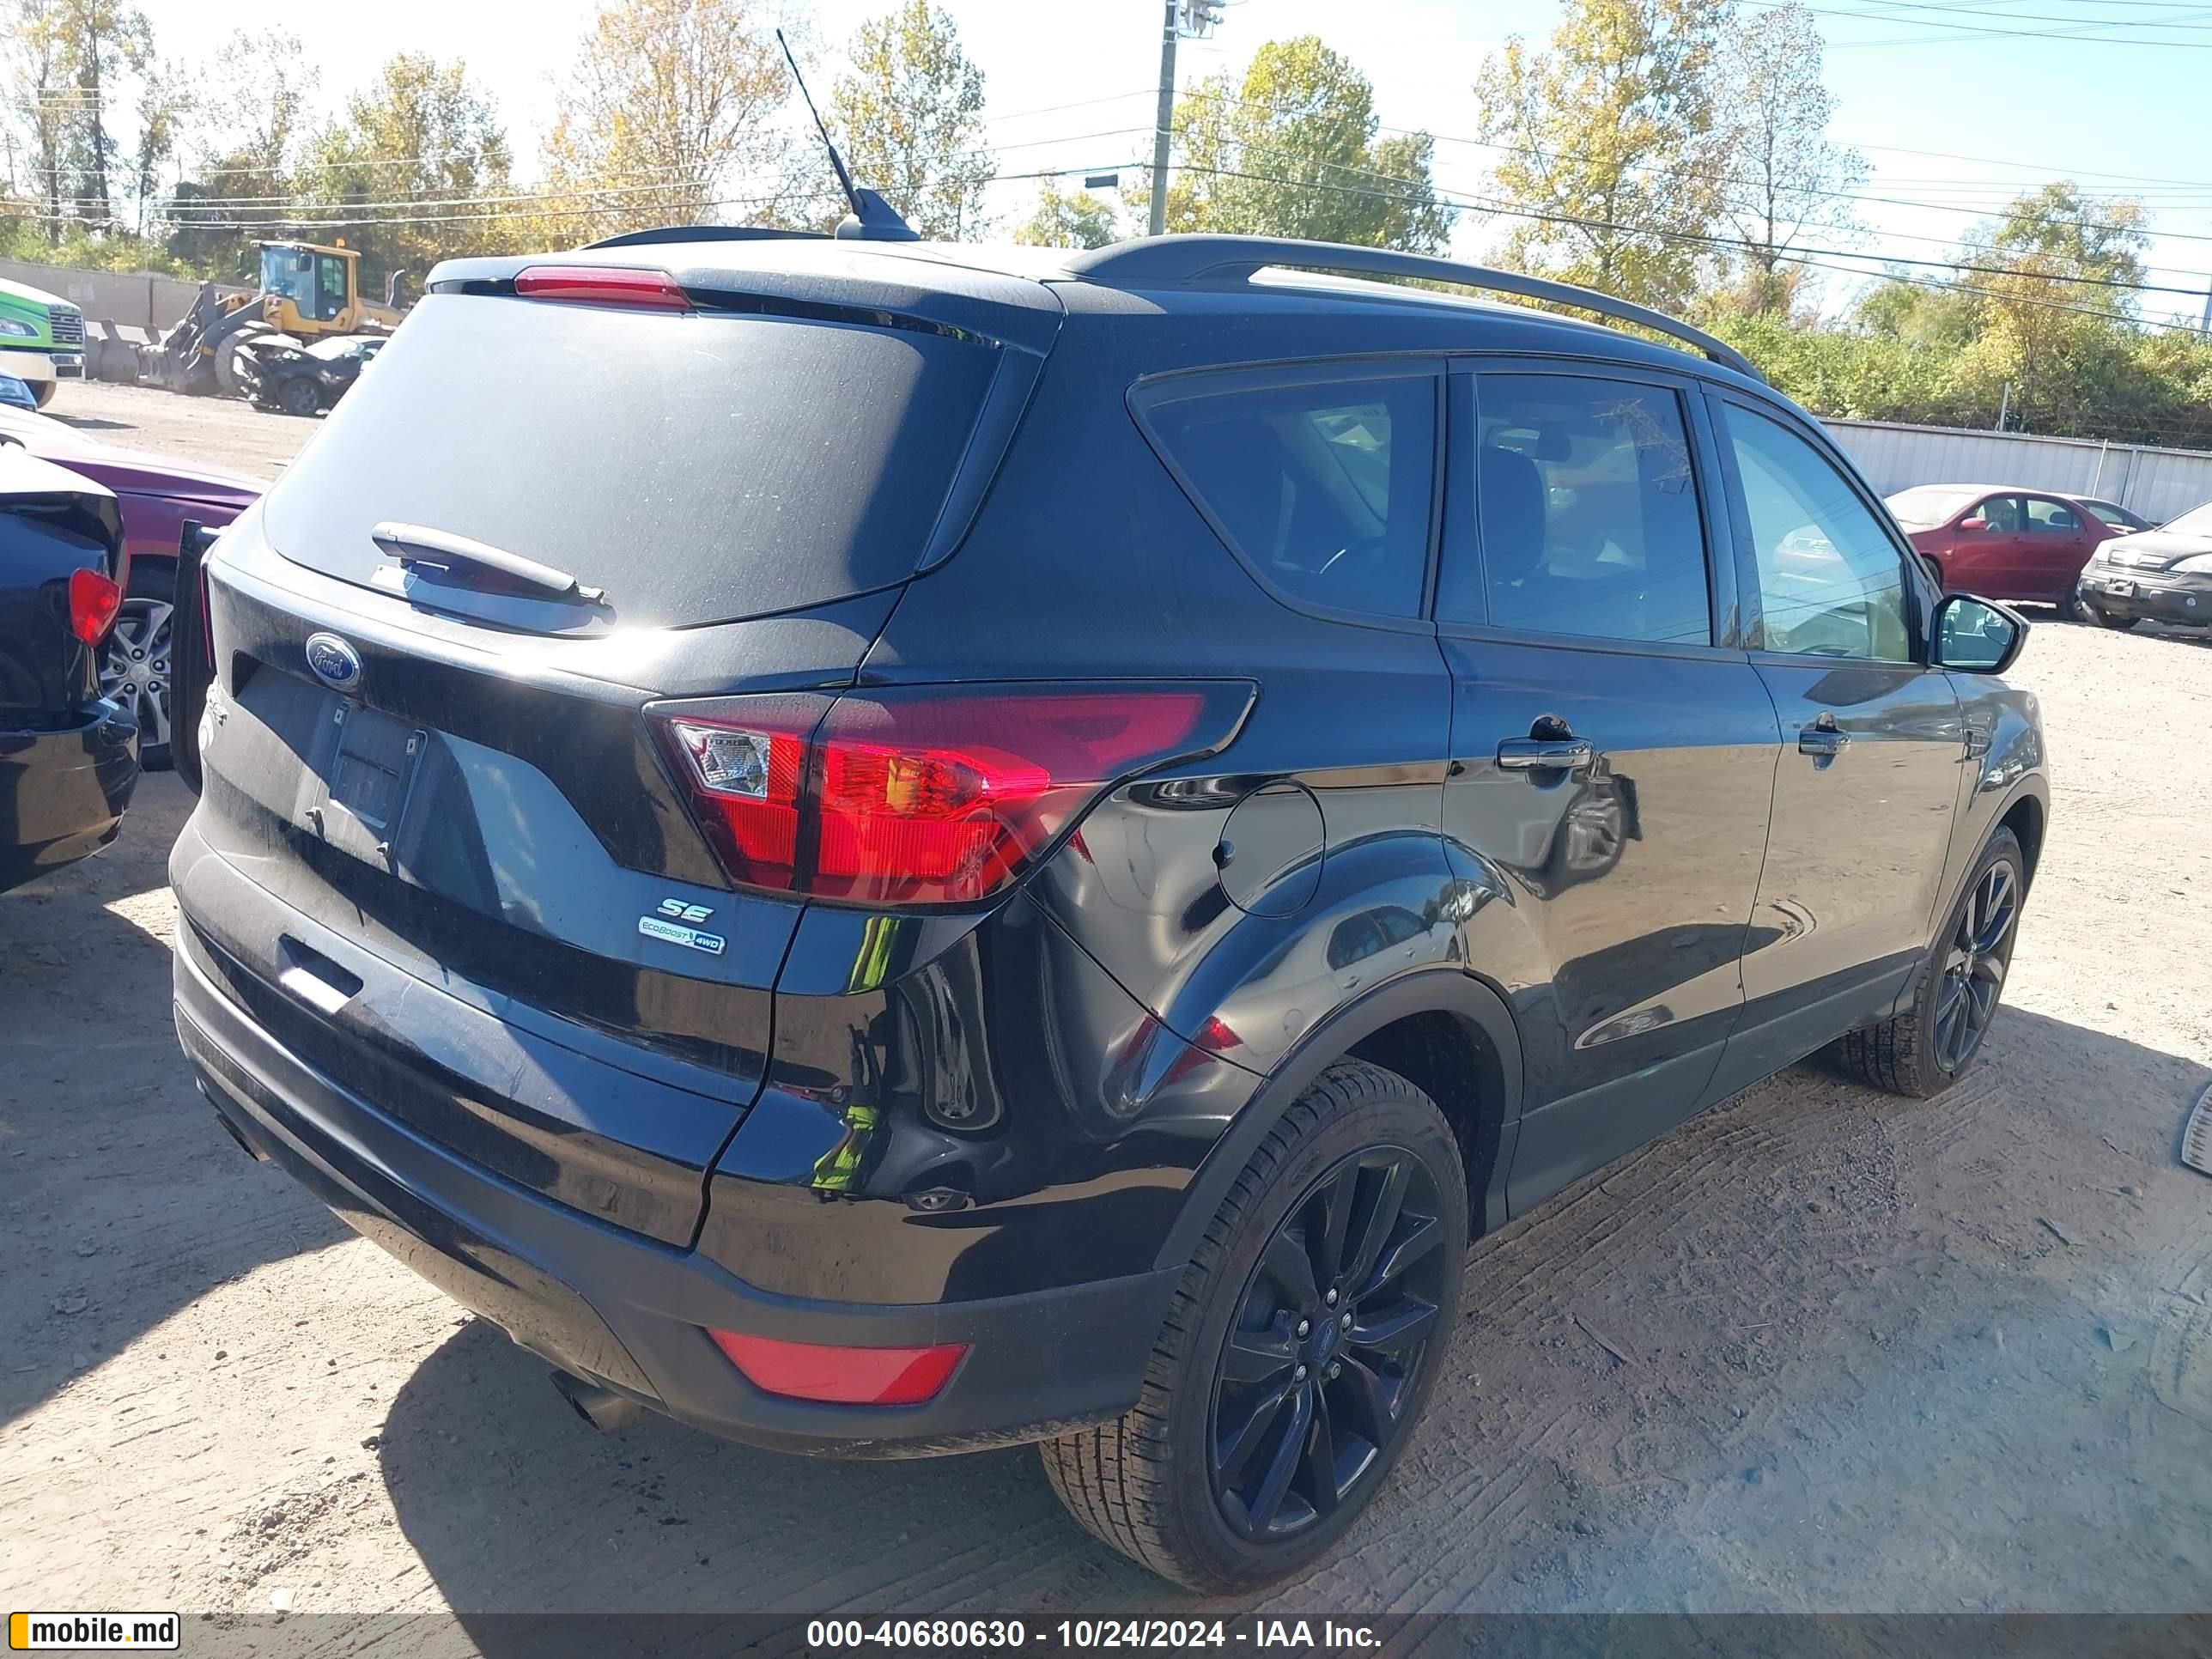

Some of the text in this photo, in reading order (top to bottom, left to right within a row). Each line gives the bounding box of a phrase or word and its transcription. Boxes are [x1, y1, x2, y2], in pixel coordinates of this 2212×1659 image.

[315, 646, 343, 677] Ford
[657, 898, 714, 923] SE
[695, 937, 720, 949] 4WD
